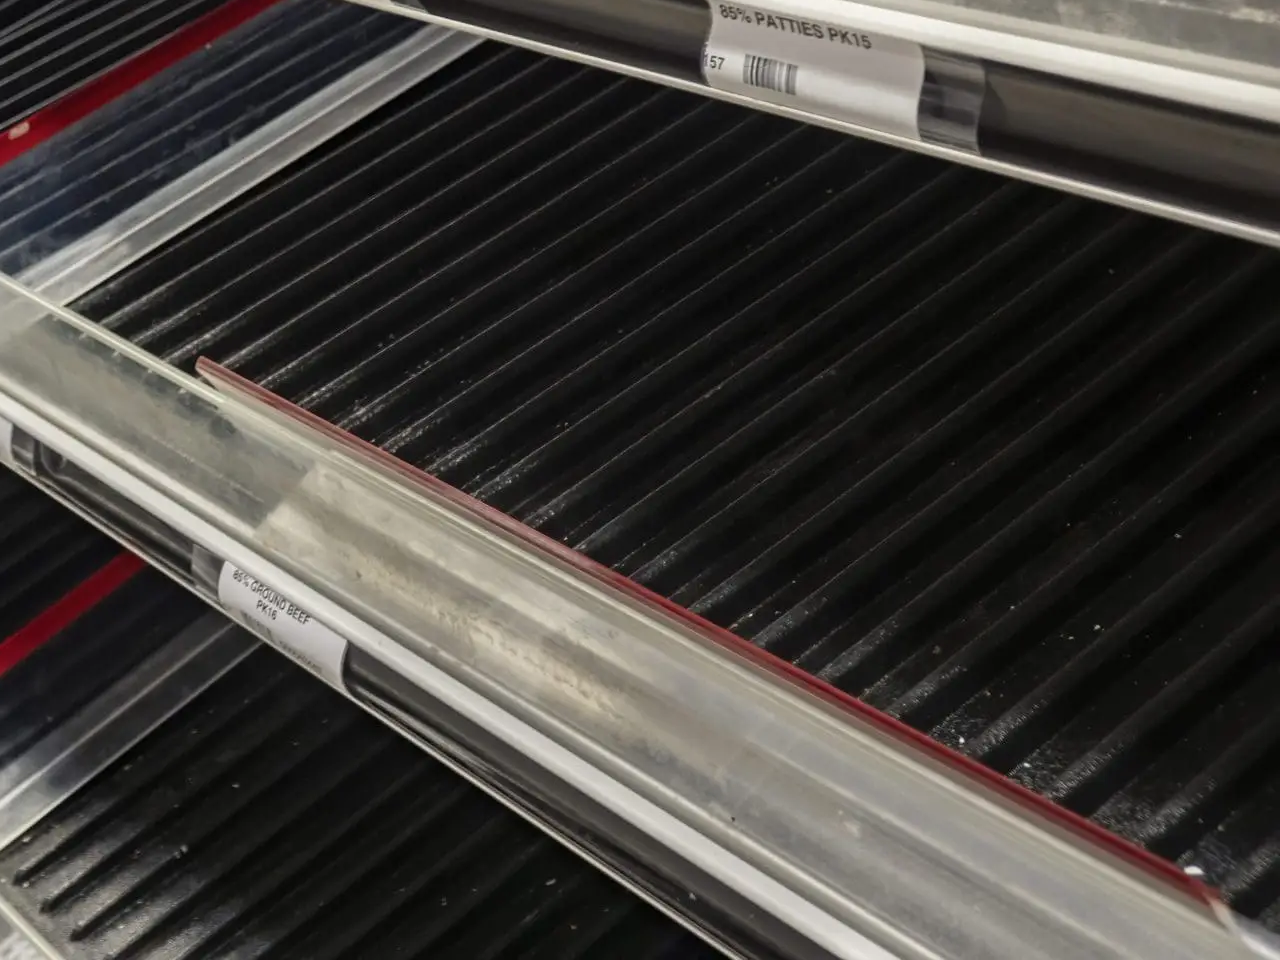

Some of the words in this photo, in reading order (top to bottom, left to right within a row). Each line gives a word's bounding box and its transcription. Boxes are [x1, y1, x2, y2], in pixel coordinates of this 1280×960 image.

[720, 4, 752, 24] 85%
[754, 11, 824, 39] PATTIES
[828, 27, 872, 50] PK15
[250, 580, 286, 610] GROUND
[287, 604, 311, 625] BEEF
